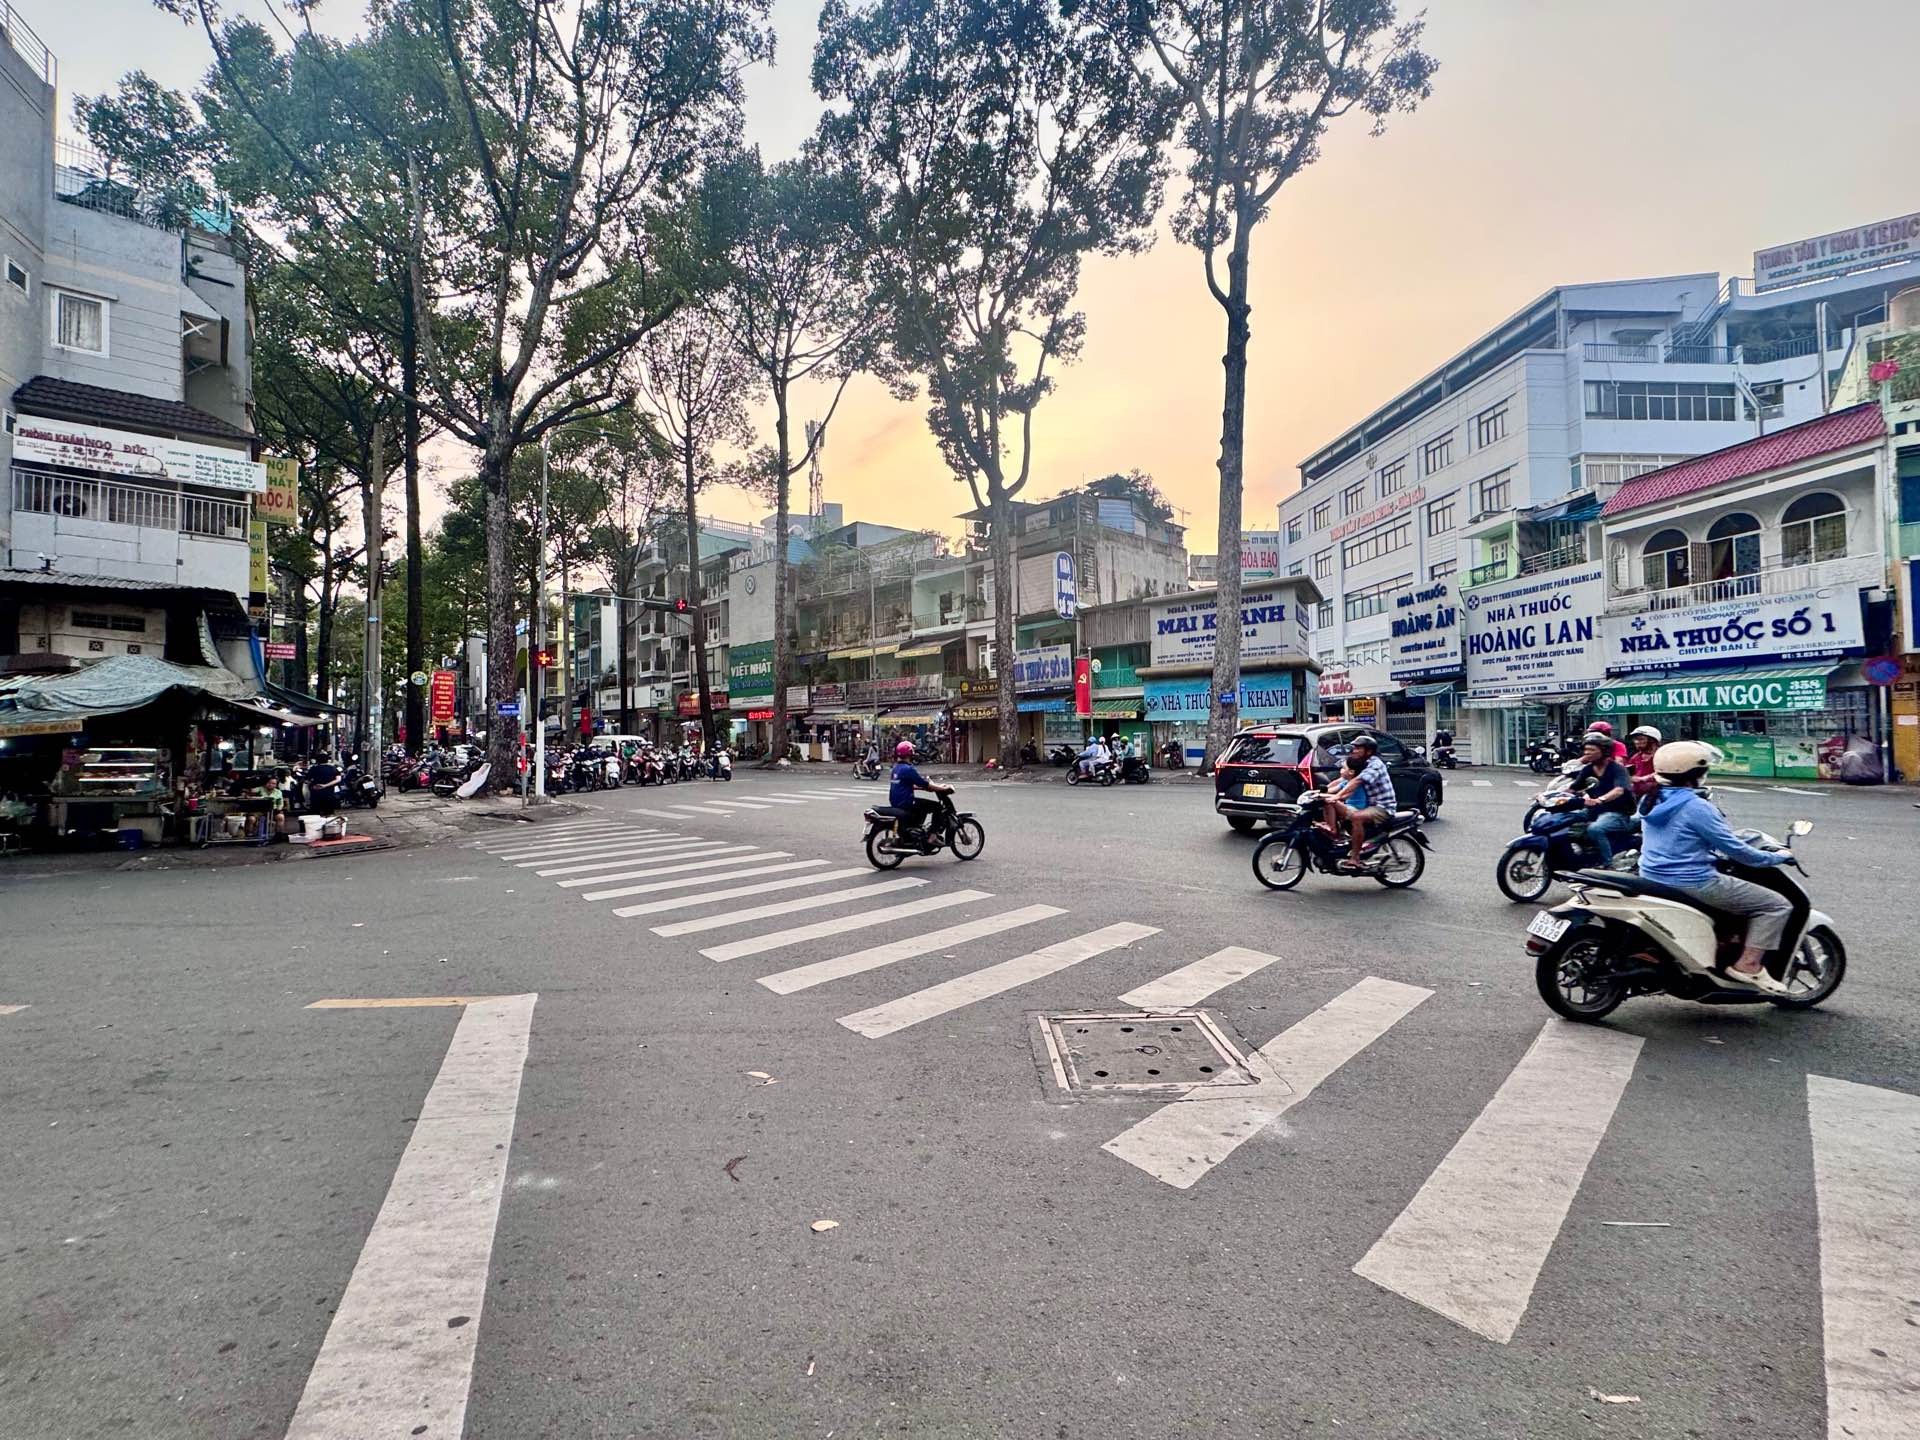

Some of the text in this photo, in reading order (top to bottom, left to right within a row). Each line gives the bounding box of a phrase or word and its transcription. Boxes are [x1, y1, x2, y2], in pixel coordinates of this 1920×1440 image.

[1806, 253, 1858, 271] MEDICAL
[1860, 242, 1909, 259] CENTER
[267, 459, 289, 474] NỘI
[1590, 571, 1602, 581] LAN
[1397, 583, 1447, 608] NHÀ THUỐC
[1487, 592, 1572, 623] NHÀ THUỐC
[1692, 608, 1760, 622] TENDIPHAR CORP
[1157, 604, 1286, 636] MAI KANH
[1392, 603, 1456, 638] HOÀNG ÂN
[1620, 606, 1836, 653] NHÀ THUỐC SỐ 1
[1401, 642, 1422, 653] CHUYÊN
[1469, 617, 1593, 655] HOÀNG LAN
[1531, 649, 1548, 660] PHẨM
[1678, 645, 1718, 656] CHUYÊN
[730, 658, 772, 680] VIỆT NHẬT
[1161, 690, 1182, 711] NHÀ
[1247, 690, 1289, 708] KHANH
[1616, 693, 1629, 707] NHÀ
[1630, 690, 1650, 706] THUỐC
[1650, 691, 1662, 705] TÂY
[1666, 687, 1709, 708] KIM
[1715, 683, 1783, 709] NGỌC
